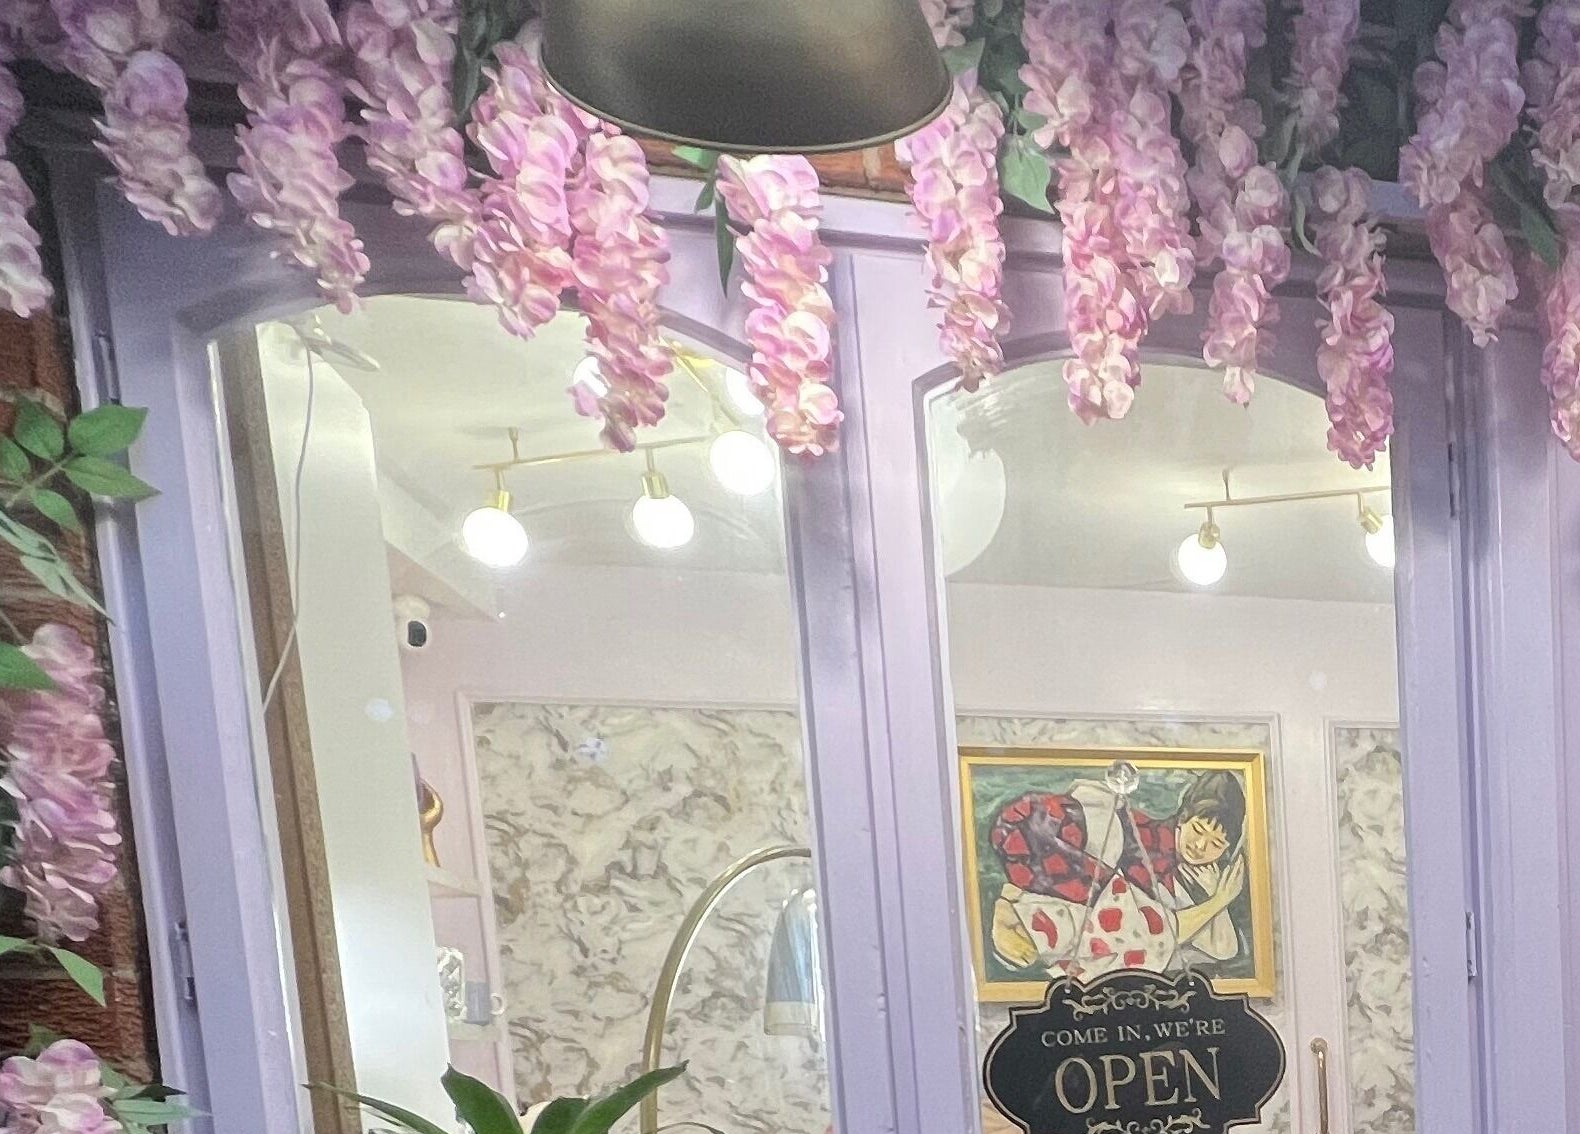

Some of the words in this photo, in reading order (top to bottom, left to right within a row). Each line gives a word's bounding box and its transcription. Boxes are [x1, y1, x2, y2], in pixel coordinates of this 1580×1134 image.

[1041, 1027, 1108, 1047] COME
[1118, 1024, 1151, 1042] IN,
[1153, 1018, 1226, 1038] WE'RE
[1055, 1047, 1221, 1114] OPEN
